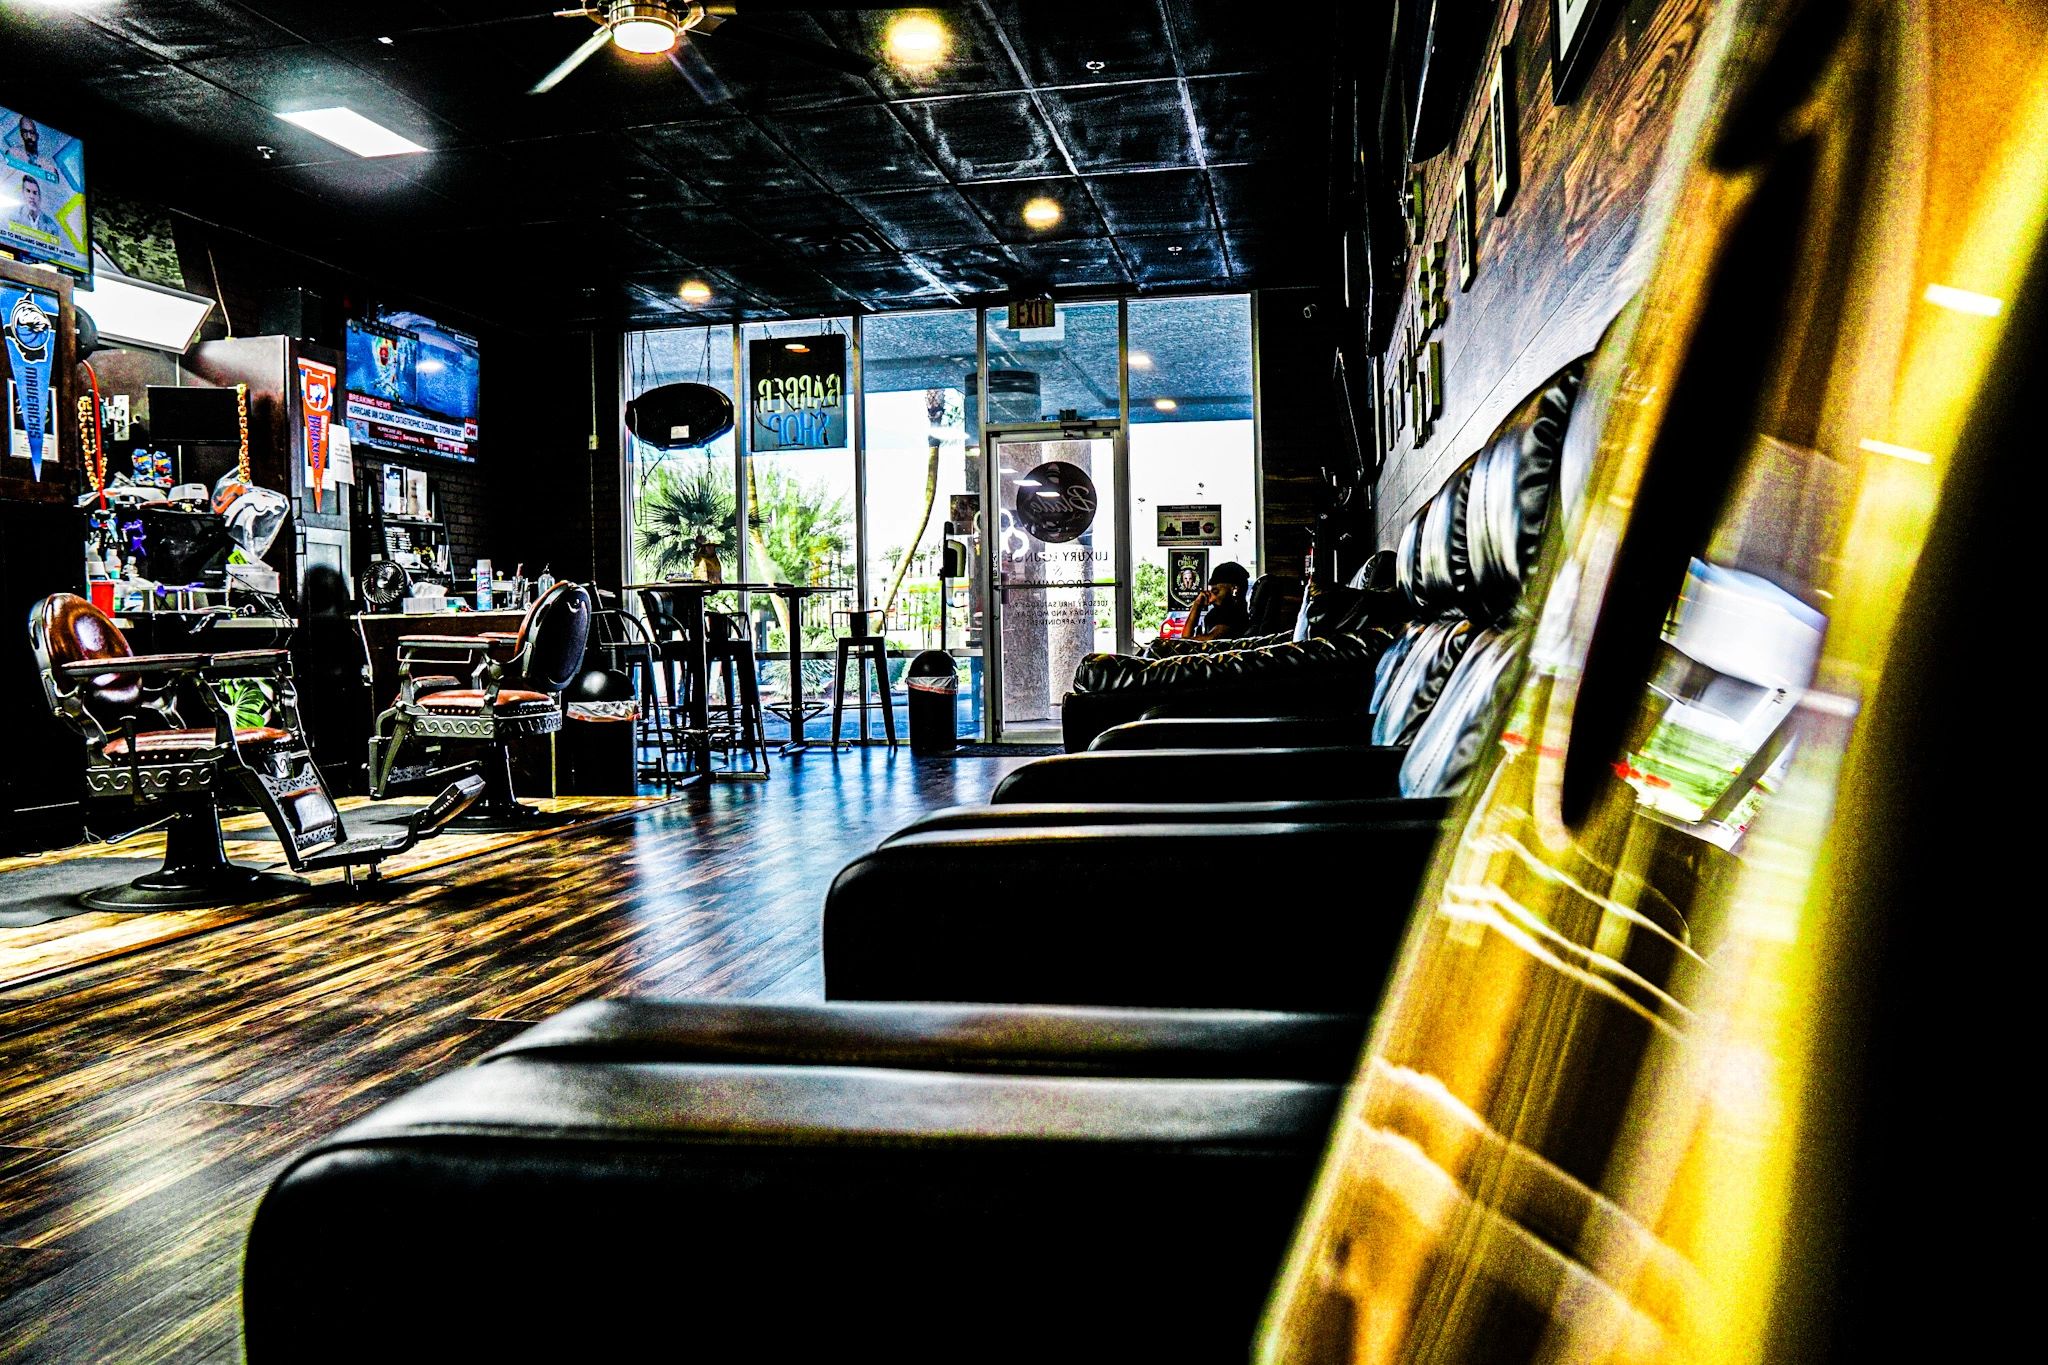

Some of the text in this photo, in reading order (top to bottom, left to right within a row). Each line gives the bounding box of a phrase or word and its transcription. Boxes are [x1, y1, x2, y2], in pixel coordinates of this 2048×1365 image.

[1016, 300, 1048, 326] EXIT
[26, 366, 41, 439] MAVERICKS
[348, 393, 392, 410] BREAKING NEWS
[379, 412, 395, 422] CAUSING
[395, 416, 420, 429] CATASTROPHIC
[308, 415, 321, 470] BRONCOS
